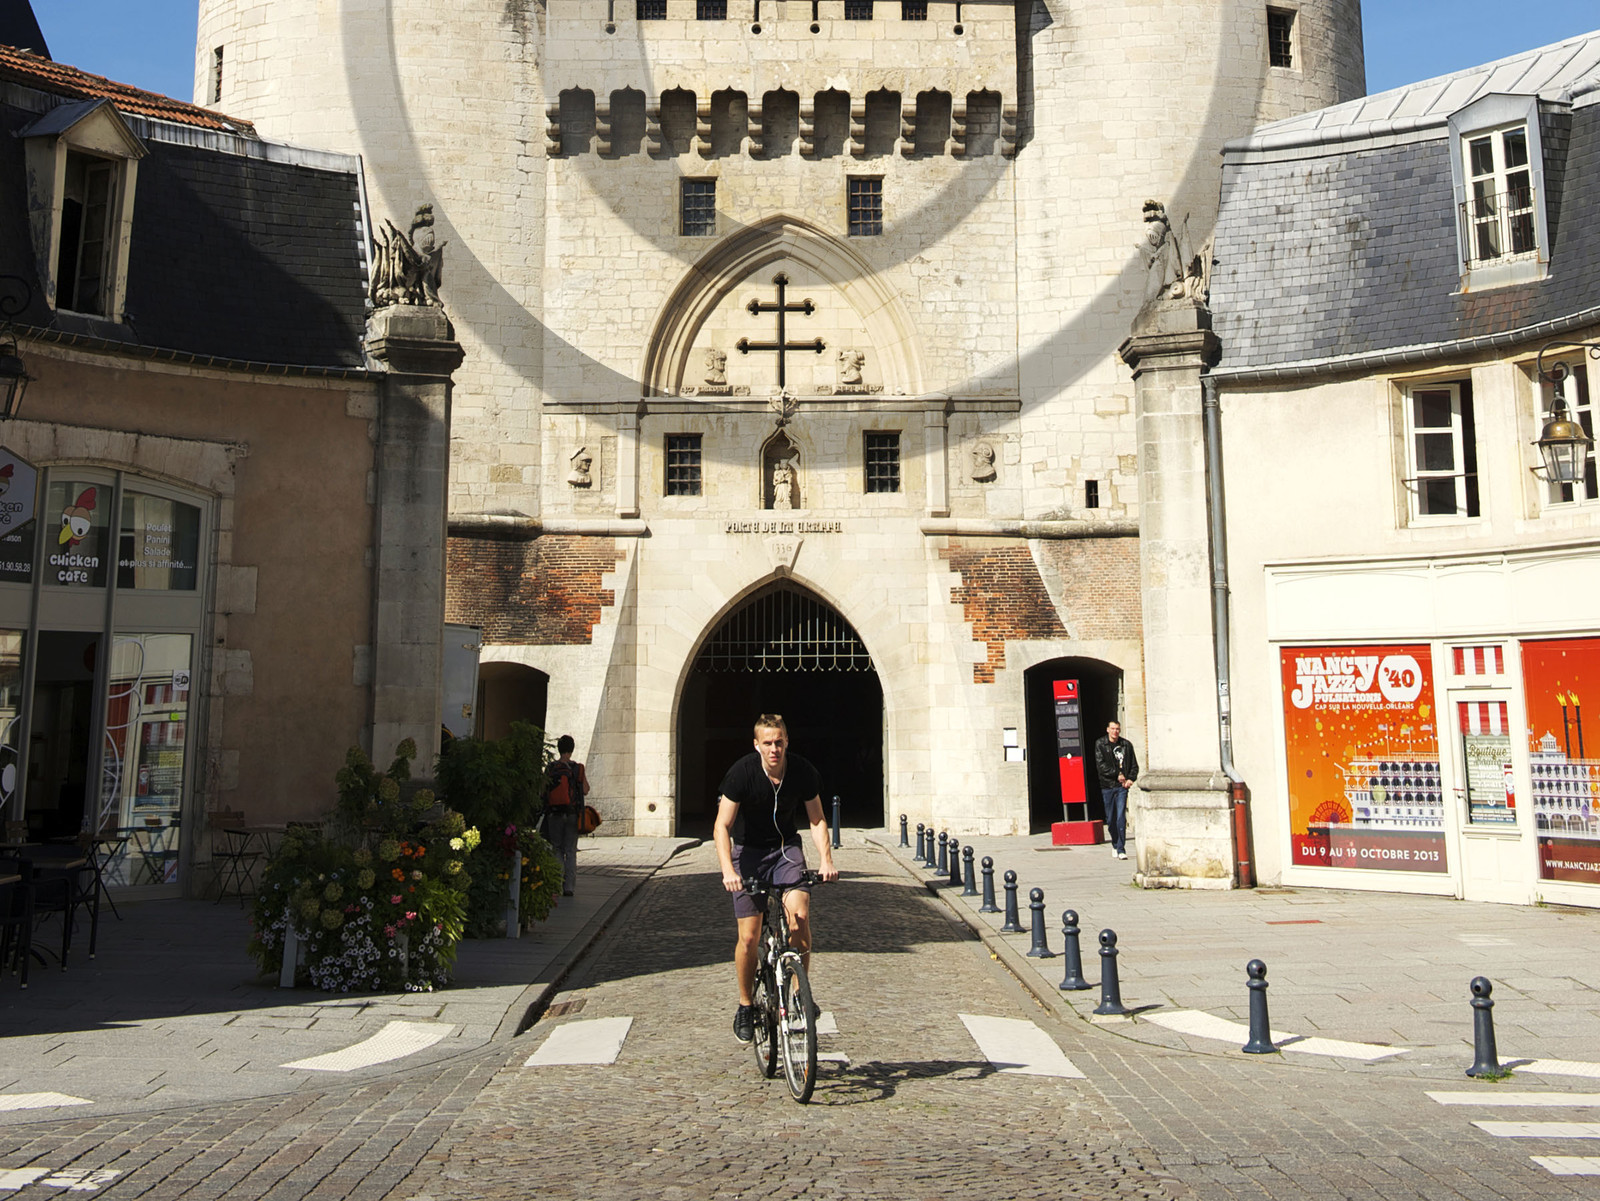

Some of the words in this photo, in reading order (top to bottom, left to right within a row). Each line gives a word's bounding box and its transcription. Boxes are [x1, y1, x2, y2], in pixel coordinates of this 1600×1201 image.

[146, 523, 172, 532] Poulet
[146, 534, 170, 543] Panini
[144, 546, 171, 556] Salade
[130, 559, 147, 569] plus
[1295, 656, 1379, 691] NANCY
[1291, 675, 1356, 709] JAZZ
[1314, 692, 1382, 703] PULSATIONS
[1328, 703, 1341, 711] SUR
[1342, 703, 1351, 711] LA
[1468, 744, 1507, 761] Boutique
[1302, 846, 1316, 856] DU
[1319, 847, 1326, 857] 9
[1329, 848, 1343, 857] AU
[1346, 848, 1357, 858] 19
[1360, 848, 1410, 860] OCTOBRE
[1413, 850, 1440, 861] 2013
[1545, 859, 1600, 872] WWW.NANCYJAZ
